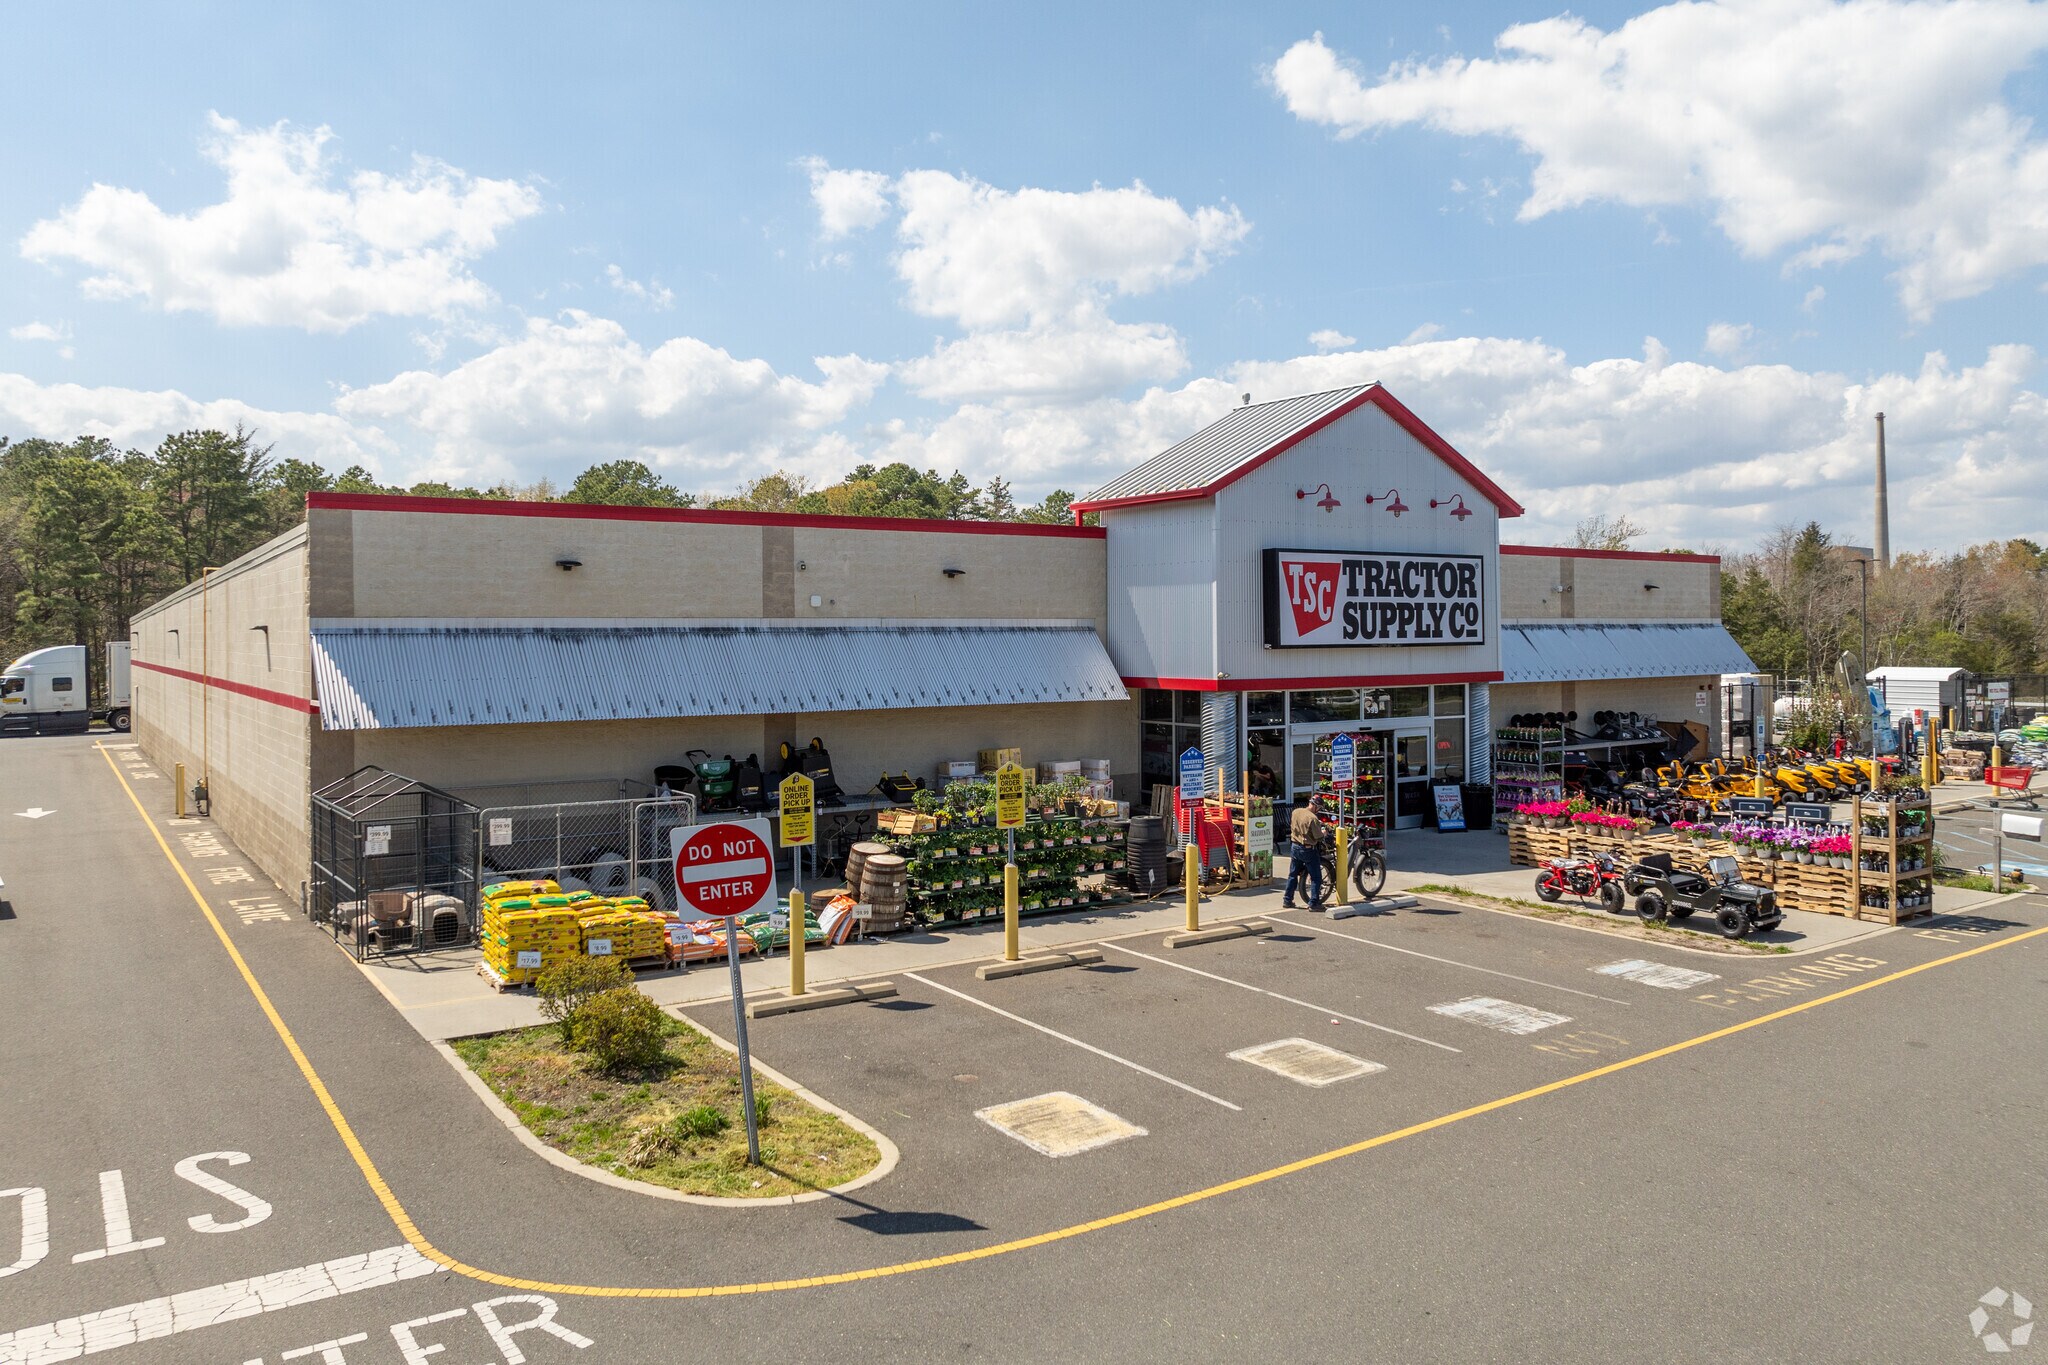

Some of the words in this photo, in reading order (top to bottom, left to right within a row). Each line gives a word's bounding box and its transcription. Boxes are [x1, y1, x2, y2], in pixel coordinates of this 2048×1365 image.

[1342, 559, 1478, 599] TRACTOR
[1288, 564, 1332, 622] TSC
[1342, 601, 1447, 640] SUPPLY
[1000, 773, 1021, 781] ONLINE
[1000, 779, 1020, 787] ORDER
[784, 785, 809, 793] ONLINE
[785, 792, 808, 800] ORDER
[784, 799, 800, 807] PICK
[688, 845, 712, 861] DO
[723, 839, 756, 856] NOT
[699, 881, 754, 901] ENTER
[228, 896, 291, 925] LANE
